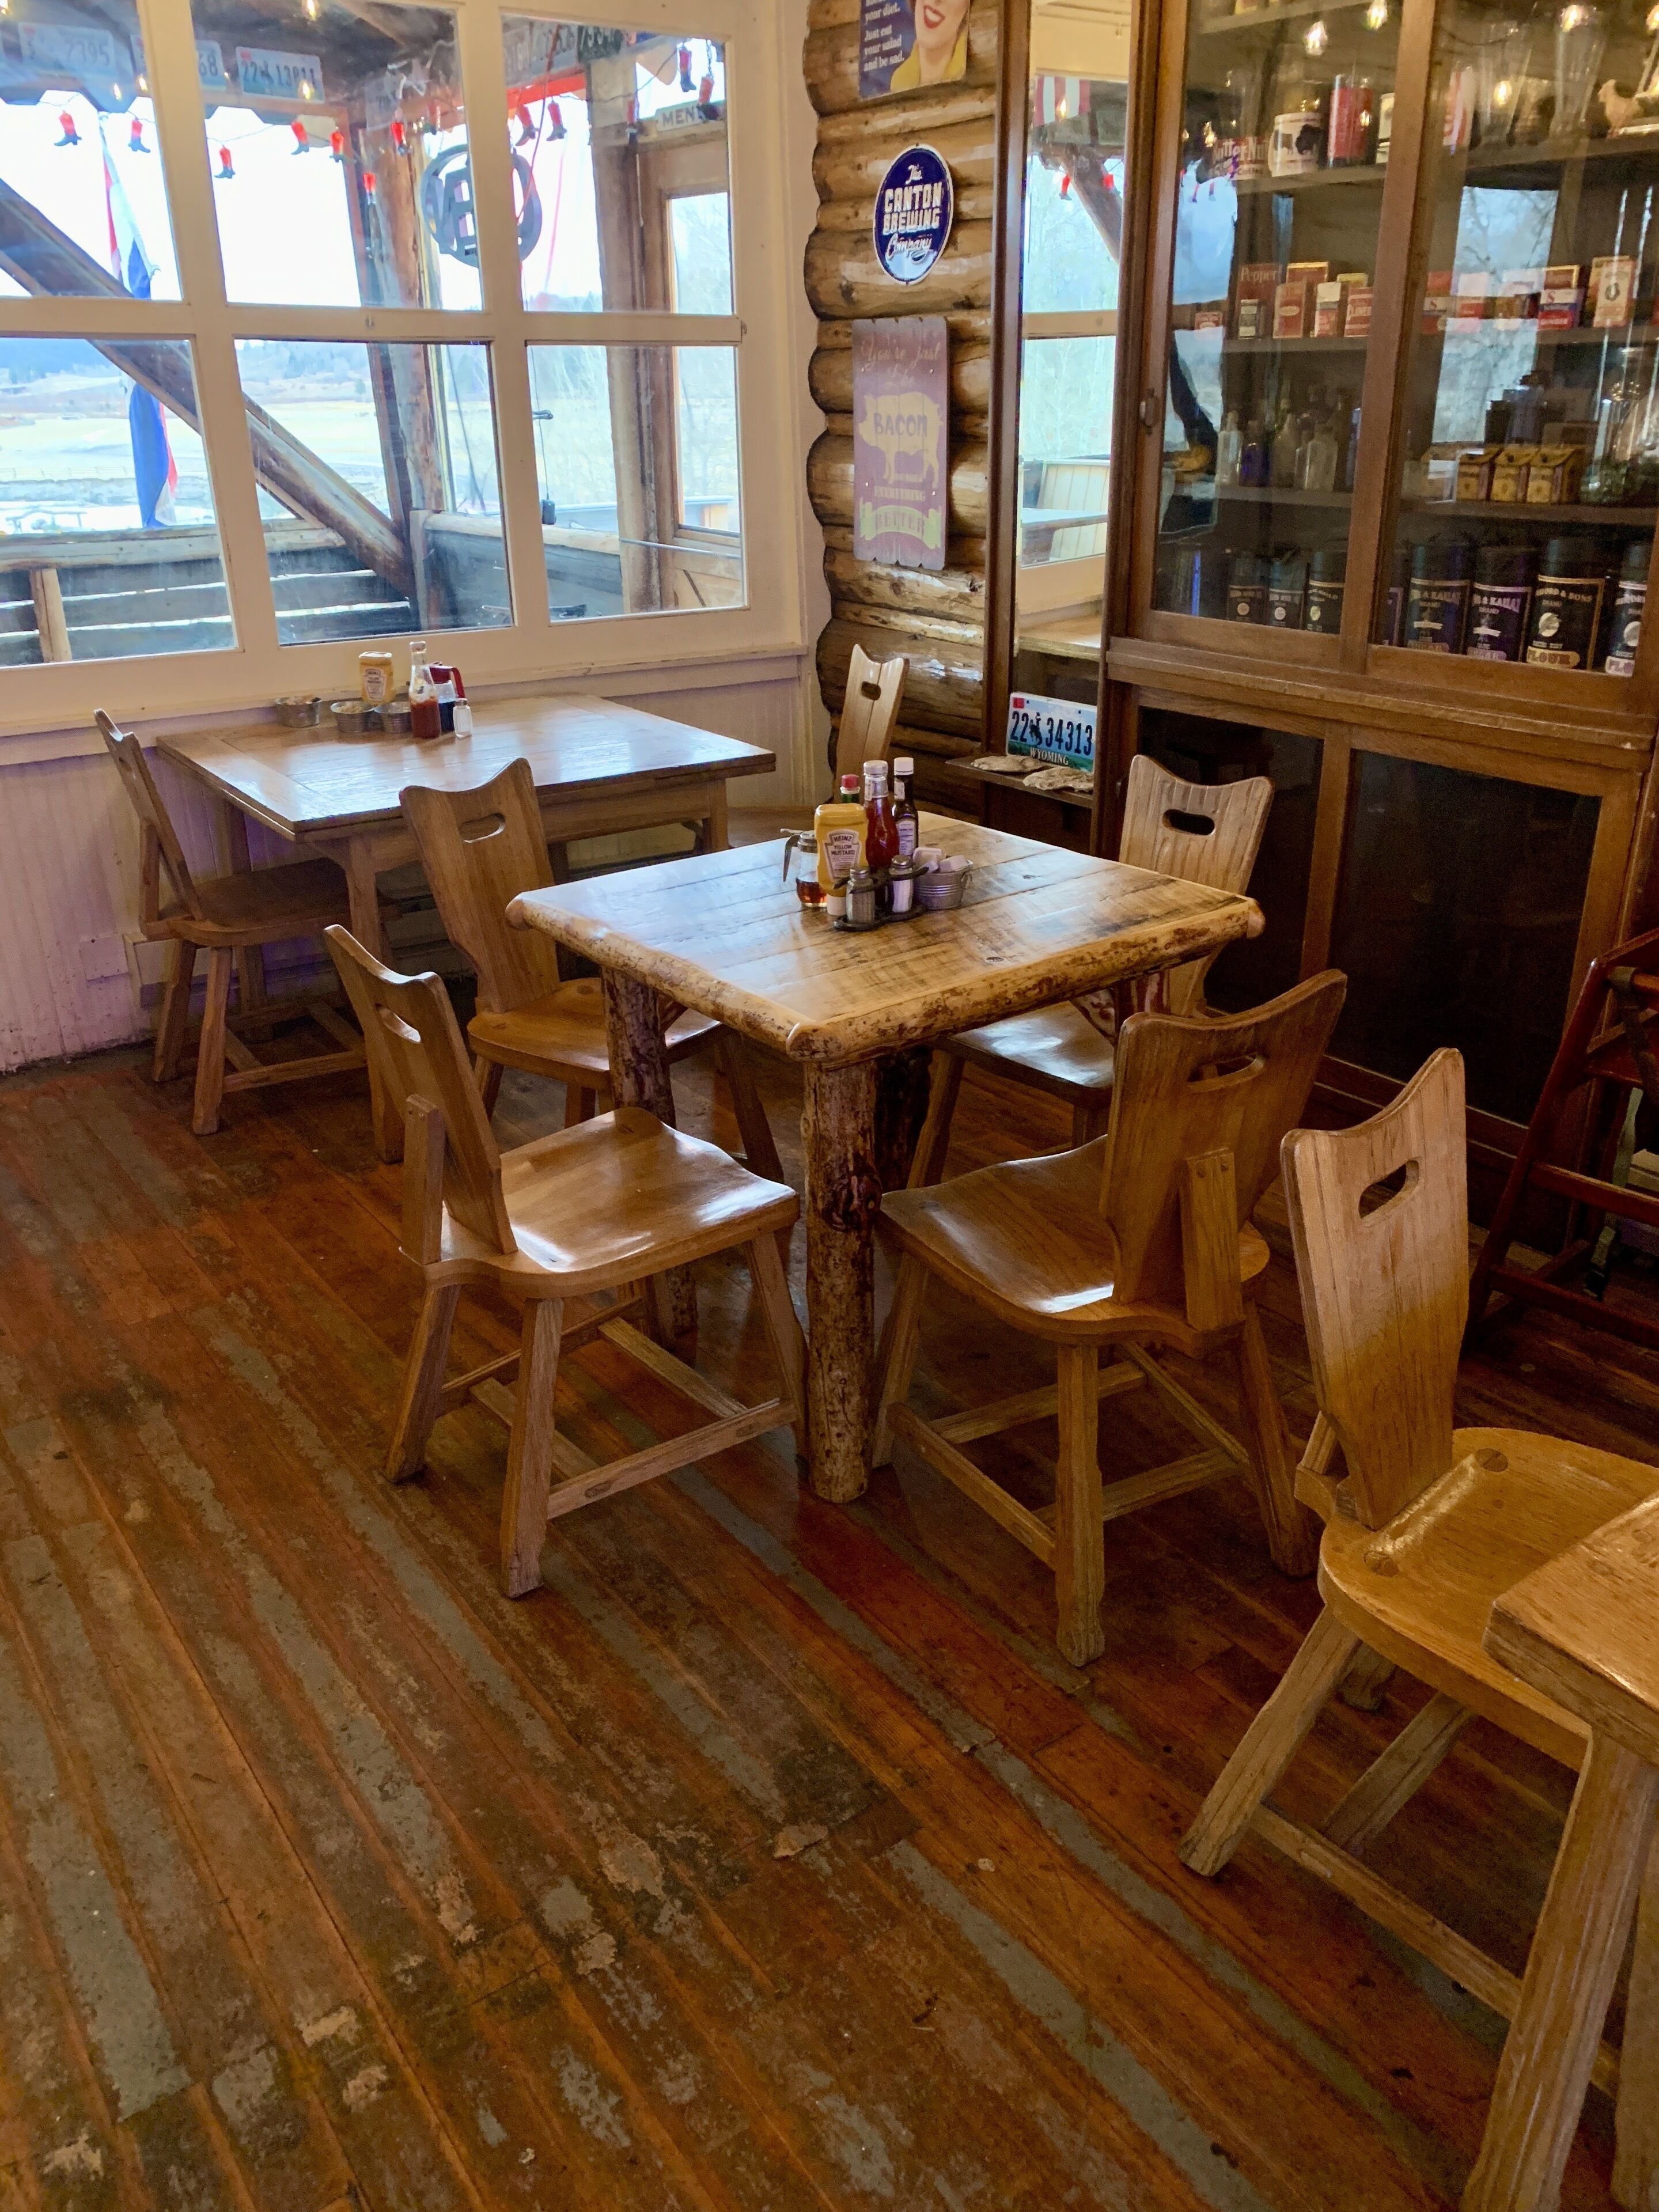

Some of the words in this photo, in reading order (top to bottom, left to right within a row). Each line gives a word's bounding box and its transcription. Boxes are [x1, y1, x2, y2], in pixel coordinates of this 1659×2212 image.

[881, 24, 892, 36] eat
[863, 56, 877, 71] and
[879, 56, 888, 67] be
[905, 164, 922, 185] The
[884, 181, 944, 214] CANTON
[882, 208, 942, 236] BREWING
[885, 232, 933, 264] Company
[873, 412, 928, 438] BACON
[1010, 710, 1029, 743] 22
[1045, 717, 1093, 756] 34313
[1030, 747, 1069, 766] WYOMING
